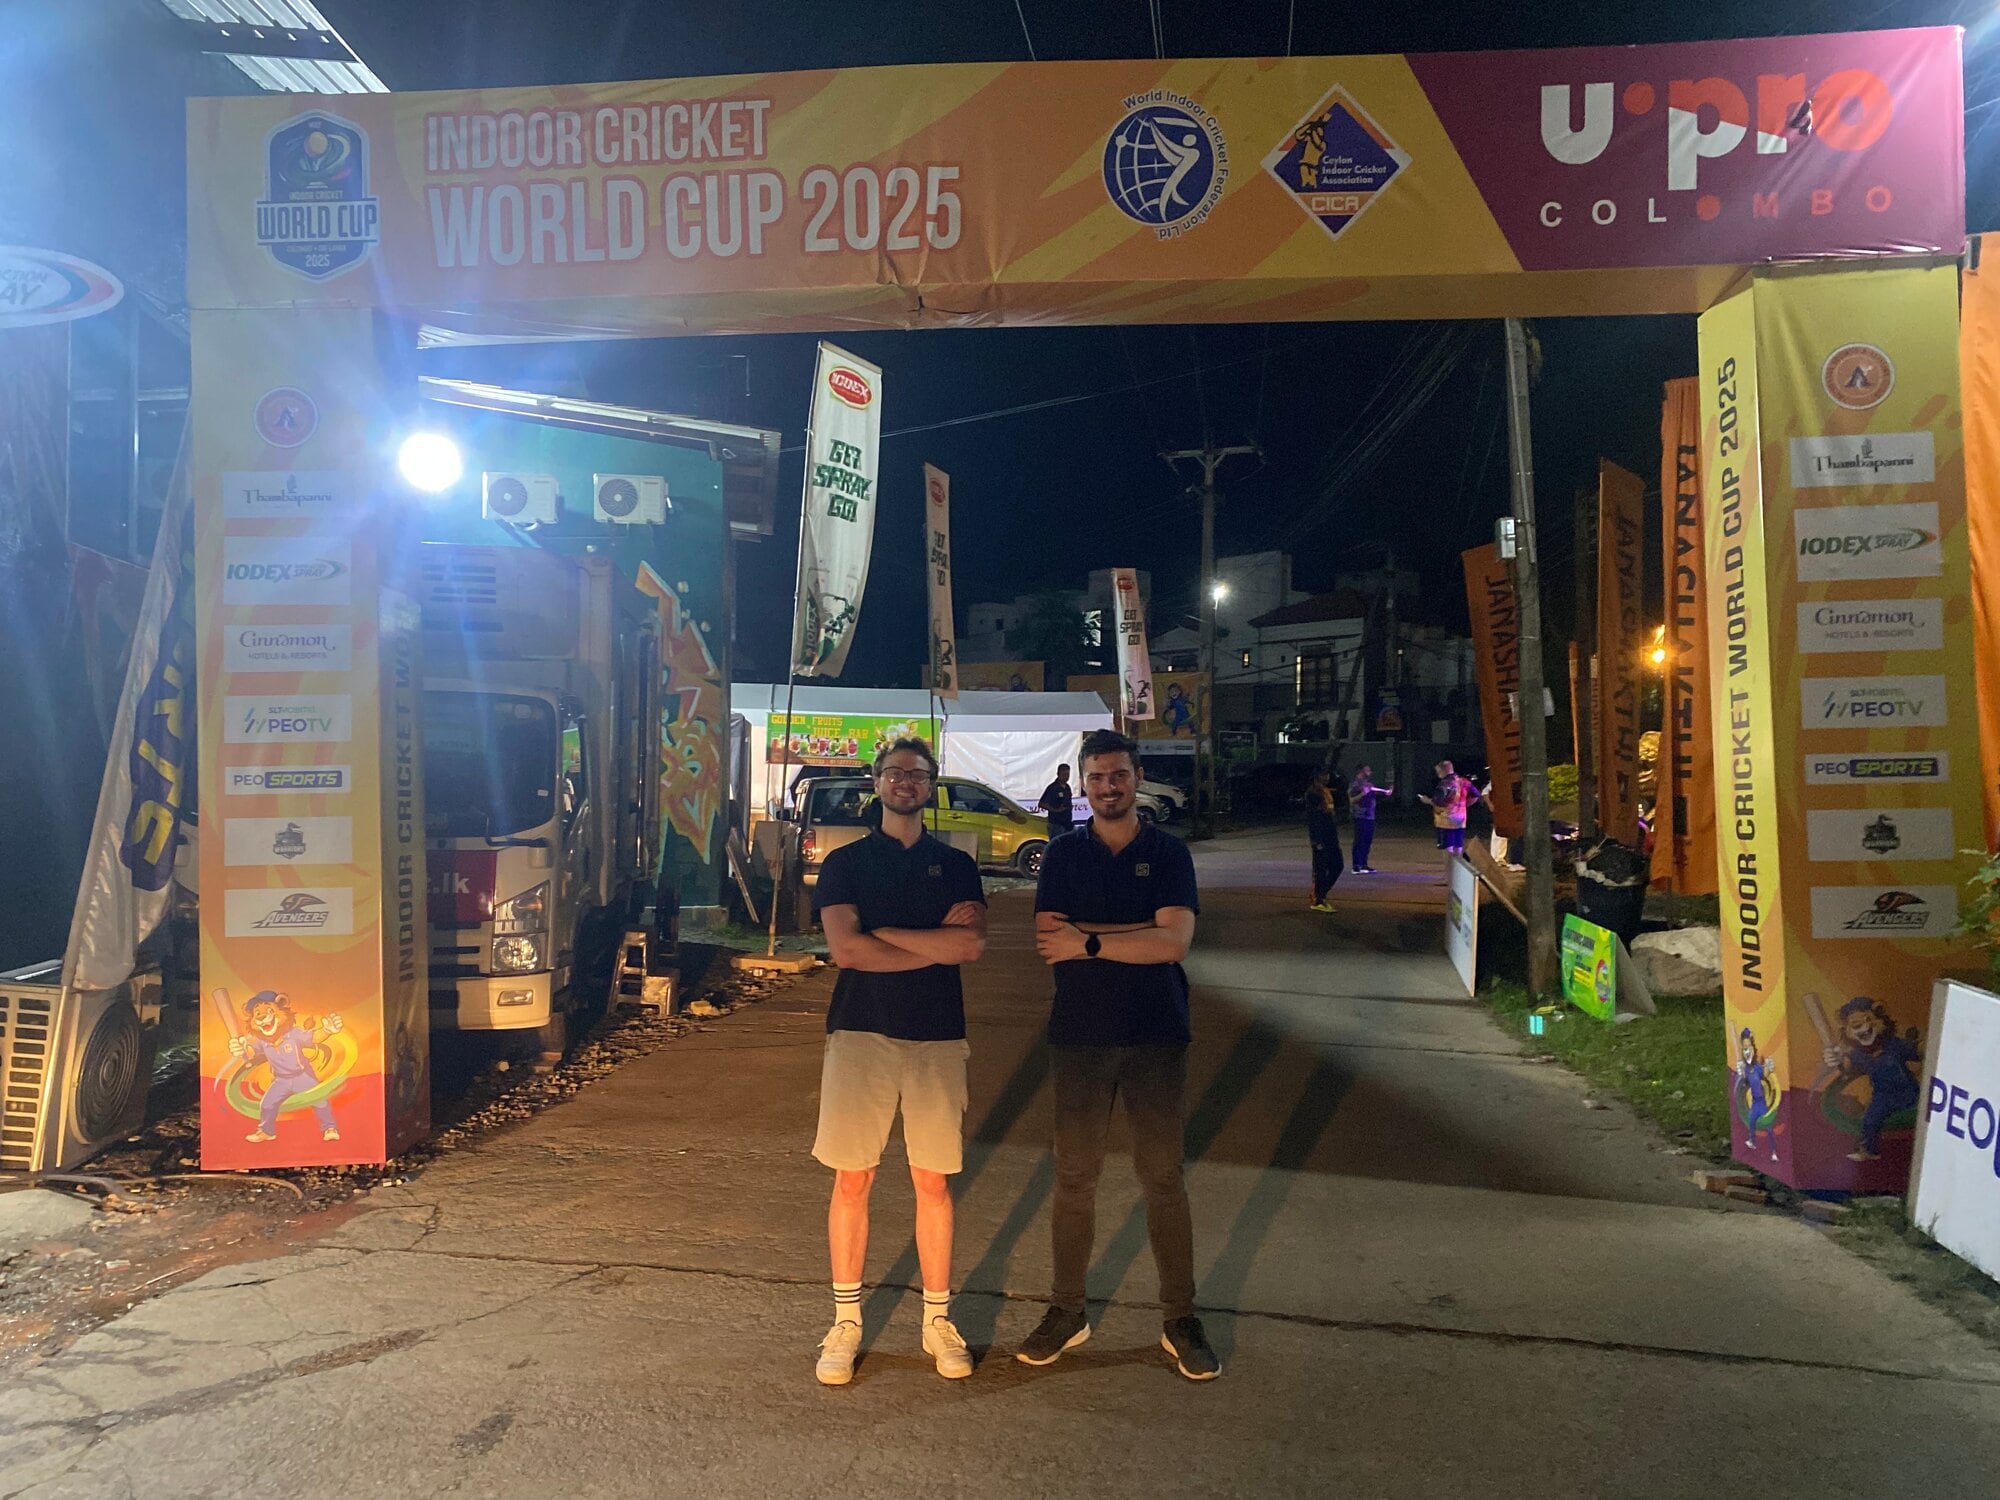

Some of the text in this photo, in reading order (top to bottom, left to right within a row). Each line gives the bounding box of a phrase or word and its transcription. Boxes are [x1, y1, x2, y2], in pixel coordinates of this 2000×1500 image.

[428, 100, 771, 171] INDOOR CRICKET
[1123, 90, 1228, 239] World Indoor Cricket Federation Ltd
[1322, 155, 1352, 165] Ceylon
[1322, 165, 1387, 175] Indoor Cricket
[1321, 176, 1374, 185] Association
[1311, 196, 1359, 211] CICA
[257, 204, 377, 240] WORLD CUP
[429, 166, 962, 267] WORLD CUP 2025
[305, 254, 331, 267] 2025
[829, 438, 862, 471] GET
[812, 463, 873, 502] SPRAY
[1800, 535, 1873, 556] IODEX
[226, 563, 293, 583] IODEX
[1815, 607, 1925, 628] Cinnamon
[239, 631, 336, 651] Cinnamon
[1717, 356, 1763, 992] INDOOR CRICKET WORLD CUP 2025
[812, 715, 844, 727] FRUITS
[813, 726, 869, 739] JUICE BAR
[396, 703, 412, 845] CRICKET
[1854, 760, 1933, 776] SPORTS
[269, 772, 338, 787] SPORTS
[264, 911, 329, 924] AVENGERS
[397, 854, 414, 984] INDOOR
[1856, 911, 1929, 926] AVENGERS
[1925, 1076, 1996, 1150] PEO
